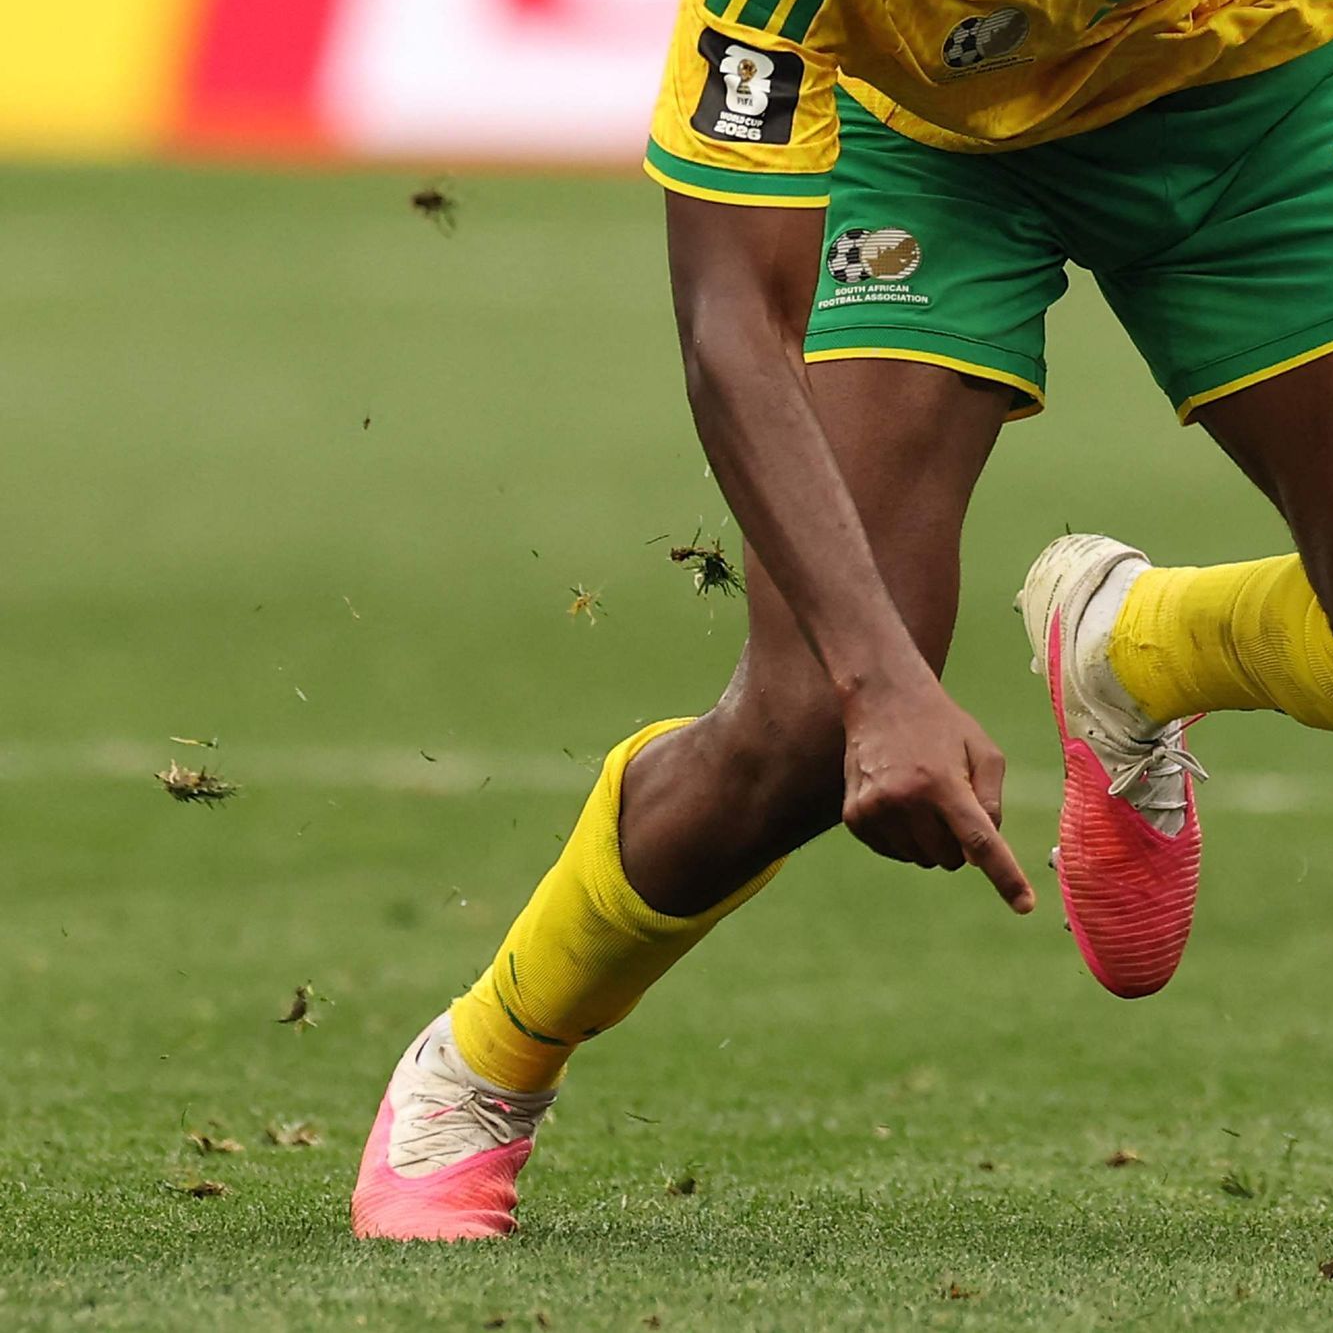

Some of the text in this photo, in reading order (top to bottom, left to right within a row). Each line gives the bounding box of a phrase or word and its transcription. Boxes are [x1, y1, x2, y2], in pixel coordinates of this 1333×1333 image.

[720, 111, 764, 127] WORLD CUP
[713, 120, 762, 141] 2026
[835, 284, 909, 297] SOUTH AFRICAN
[818, 293, 929, 310] FOOTBALL ASSOCIATION
